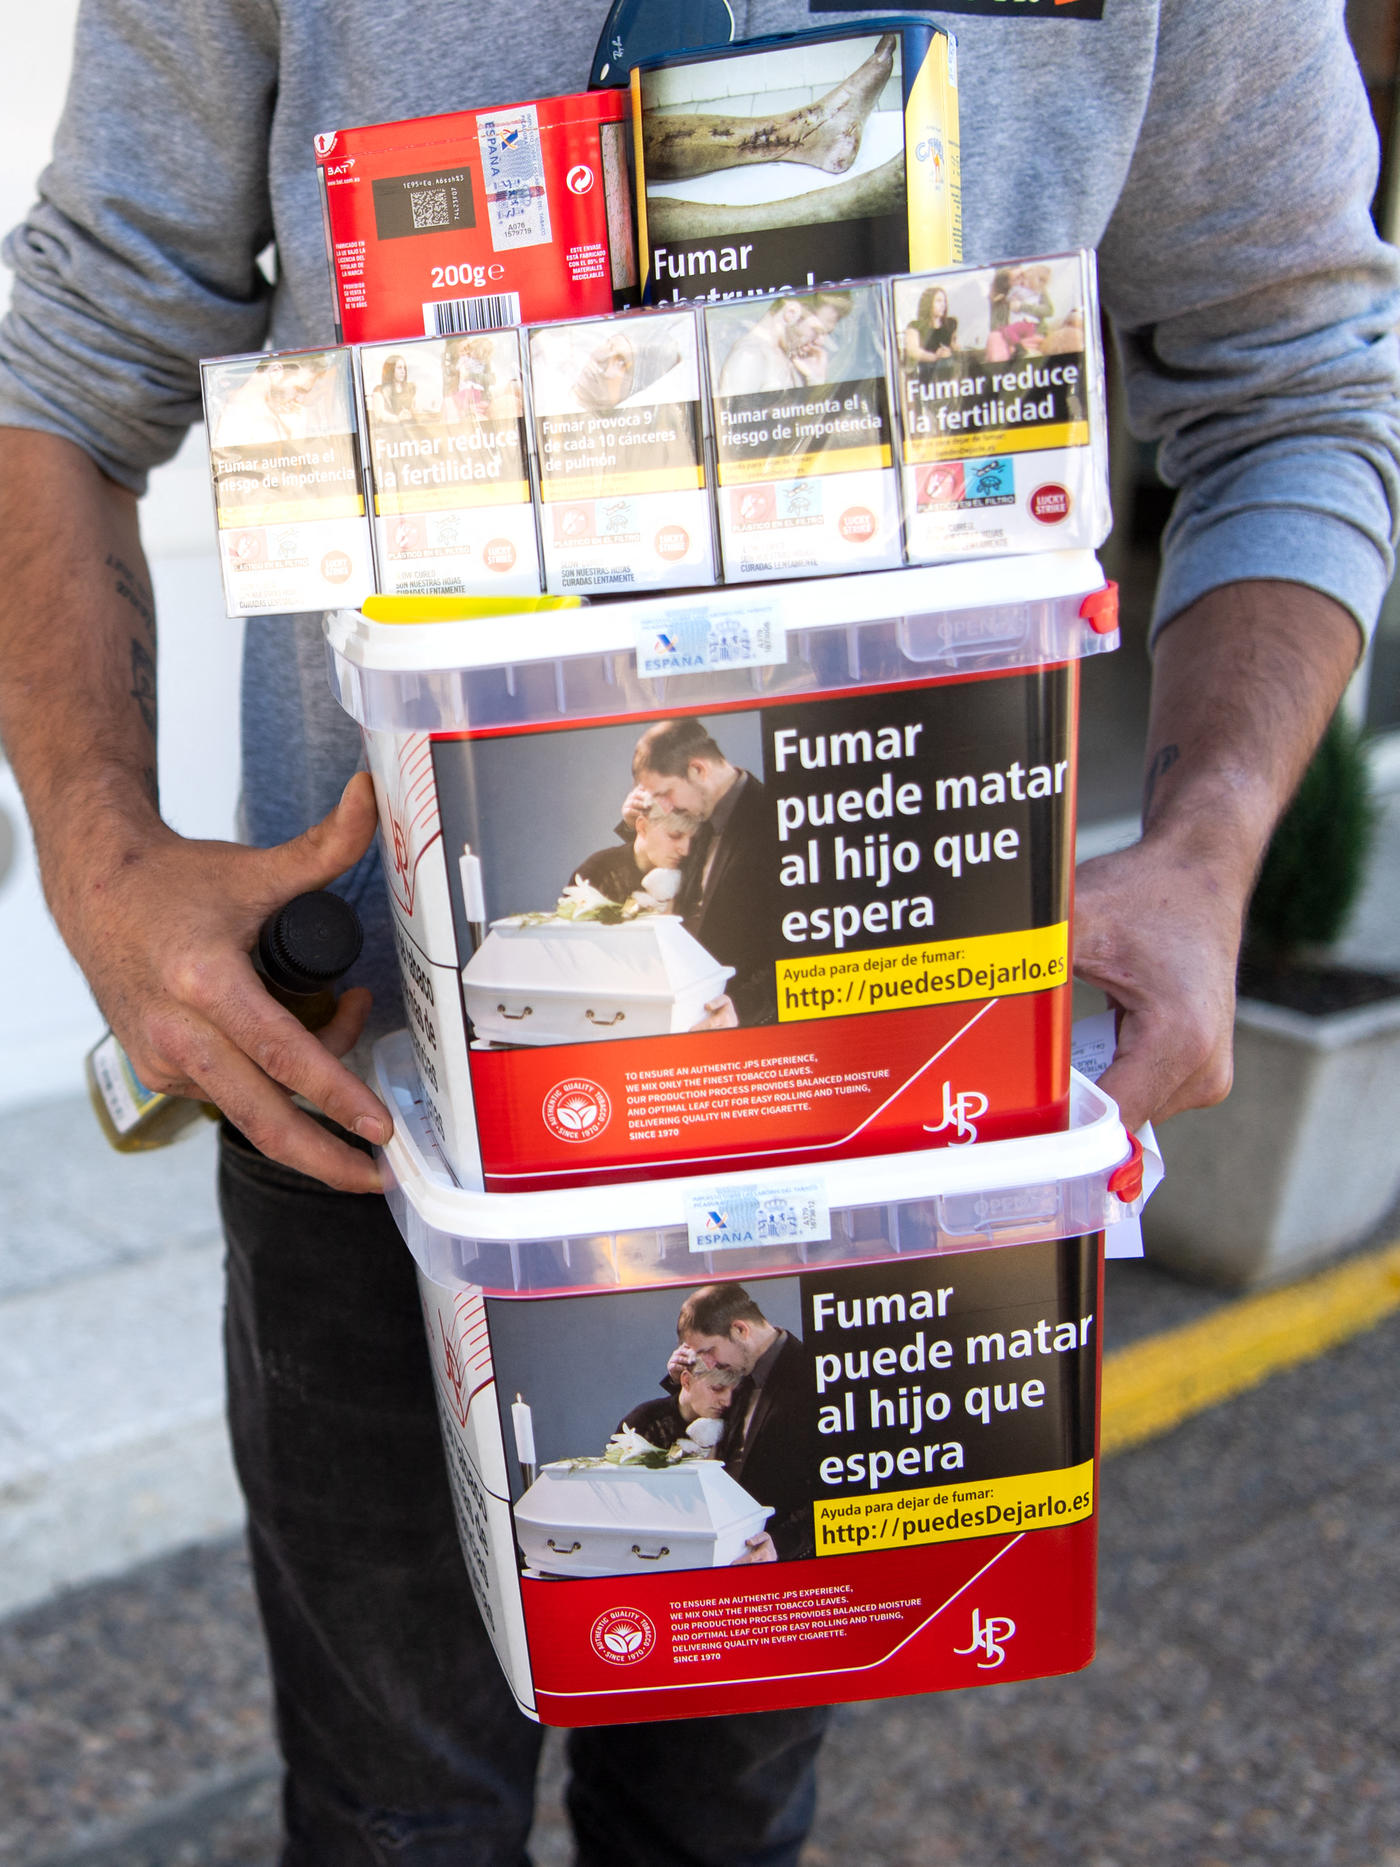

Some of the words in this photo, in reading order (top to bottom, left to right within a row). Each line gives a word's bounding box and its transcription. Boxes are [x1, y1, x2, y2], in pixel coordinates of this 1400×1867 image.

[485, 121, 500, 176] ESPAÑA
[327, 164, 349, 175] BAT
[580, 250, 606, 259] FABRICADO
[654, 245, 753, 280] Fumar
[431, 264, 486, 288] 200g
[572, 271, 604, 280] RECICLABLES
[573, 264, 602, 274] MATERIALES
[907, 375, 986, 403] Fumar
[992, 363, 1078, 392] reduce
[543, 420, 585, 435] Fumar
[588, 415, 640, 433] provoca
[643, 412, 652, 425] 9
[720, 409, 768, 426] Fumar
[772, 400, 840, 419] aumenta
[844, 394, 858, 410] el
[909, 409, 931, 433] la
[936, 394, 1055, 430] fertilidad
[375, 437, 441, 459] Fumar
[447, 428, 518, 452] reduce
[544, 438, 562, 453] de
[564, 435, 595, 451] cada
[599, 433, 615, 448] 10
[618, 429, 676, 446] cánceres
[722, 430, 769, 446] riesgo
[772, 425, 791, 440] de
[795, 416, 882, 439] impotencia
[218, 459, 258, 473] Fumar
[262, 453, 320, 468] aumenta
[322, 448, 335, 463] el
[378, 466, 397, 489] la
[401, 455, 501, 486] fertilidad
[546, 458, 562, 472] de
[565, 453, 616, 473] pulmón
[219, 479, 259, 494] riesgo
[262, 472, 279, 488] de
[282, 467, 355, 489] impotencia
[984, 495, 1015, 506] FILTRO
[1035, 504, 1066, 515] STRIKE
[1036, 495, 1065, 505] LUCKY
[562, 577, 593, 587] CURADAS
[593, 574, 635, 585] LENTAMENTE
[645, 655, 704, 671] ESPAÑA
[774, 723, 922, 772] Fumar
[777, 772, 922, 841] puede
[936, 760, 1068, 810] matar
[780, 839, 819, 886] al
[834, 833, 920, 887] hijo
[934, 827, 1019, 878] que
[782, 896, 934, 948] espera
[784, 966, 826, 981] Ayuda
[830, 963, 860, 978] para
[864, 958, 898, 973] dejar
[902, 954, 918, 966] de
[921, 950, 965, 964] fumar:
[786, 956, 1064, 1010] http://puedesDejarlo.es
[624, 1072, 638, 1080] TO
[639, 1068, 674, 1079] ENSURE
[676, 1067, 689, 1075] AN
[690, 1062, 741, 1074] AUTHENTIC
[742, 1060, 760, 1069] JPS
[760, 1054, 818, 1067] EXPERIENCE,
[625, 1083, 639, 1092] WE
[641, 1082, 658, 1090] MIX
[658, 1080, 682, 1089] ONLY
[683, 1078, 701, 1087] THE
[703, 1074, 734, 1084] FINEST
[735, 1070, 777, 1081] TOBACCO
[778, 1066, 813, 1077] LEAVES.
[626, 1095, 646, 1104] OUR
[648, 1090, 707, 1102] PRODUCTION
[708, 1085, 749, 1096] PROCESS
[750, 1080, 795, 1091] PROVIDES
[796, 1075, 842, 1087] BALANCED
[844, 1070, 889, 1081] MOISTURE
[627, 1107, 646, 1116] AND
[647, 1104, 687, 1114] OPTIMAL
[688, 1101, 709, 1110] LEAF
[711, 1099, 729, 1108] CUT
[731, 1097, 749, 1106] FOR
[750, 1094, 772, 1104] EASY
[773, 1090, 812, 1101] ROLLING
[813, 1088, 833, 1097] AND
[834, 1084, 871, 1094] TUBING,
[628, 1116, 680, 1128] DELIVERING
[681, 1112, 719, 1123] QUALITY
[720, 1111, 730, 1119] IN
[731, 1108, 759, 1118] EVERY
[760, 1103, 811, 1115] CIGARETTE.
[629, 1130, 656, 1140] SINCE
[658, 1129, 679, 1137] 1970
[697, 1231, 753, 1246] ESPAÑA
[813, 1286, 954, 1331] Fumar
[815, 1331, 953, 1394] puede
[967, 1314, 1094, 1365] matar
[817, 1392, 855, 1434] al
[870, 1386, 951, 1435] hijo
[965, 1378, 1046, 1425] que
[819, 1441, 965, 1490] espera
[821, 1505, 861, 1521] Ayuda
[865, 1502, 894, 1516] para
[897, 1496, 930, 1512] dejar
[933, 1494, 949, 1505] de
[952, 1488, 994, 1503] fumar:
[822, 1492, 1090, 1546] http://puedesDejarlo.es
[669, 1601, 681, 1609] TO
[682, 1598, 716, 1608] ENSURE
[718, 1597, 730, 1605] AN
[732, 1592, 780, 1603] AUTHENTIC
[782, 1590, 798, 1599] JPS
[799, 1585, 853, 1597] EXPERIENCE,
[669, 1612, 683, 1620] WE
[701, 1609, 724, 1617] ONLY
[725, 1607, 742, 1615] THE
[744, 1604, 773, 1613] FINEST
[775, 1600, 814, 1610] TOBACCO
[815, 1596, 849, 1606] LEAVES.
[670, 1622, 689, 1631] OUR
[691, 1618, 747, 1628] PRODUCTION
[749, 1613, 788, 1623] PROCESS
[789, 1609, 831, 1619] PROVIDES
[833, 1603, 877, 1615] BALANCED
[878, 1598, 921, 1609] MOISTURE
[671, 1633, 690, 1641] AND
[691, 1630, 728, 1640] OPTIMAL
[730, 1628, 750, 1636] LEAF
[751, 1626, 769, 1634] CUT
[770, 1624, 788, 1632] FOR
[789, 1622, 810, 1631] EASY
[811, 1618, 848, 1628] ROLLING
[849, 1615, 867, 1624] AND
[869, 1612, 903, 1621] TUBING,
[672, 1641, 722, 1652] DELIVERING
[723, 1638, 759, 1648] QUALITY
[771, 1634, 797, 1643] EVERY
[798, 1630, 846, 1640] CIGARETTE.
[673, 1654, 698, 1663] SINCE
[701, 1652, 721, 1661] 1970
